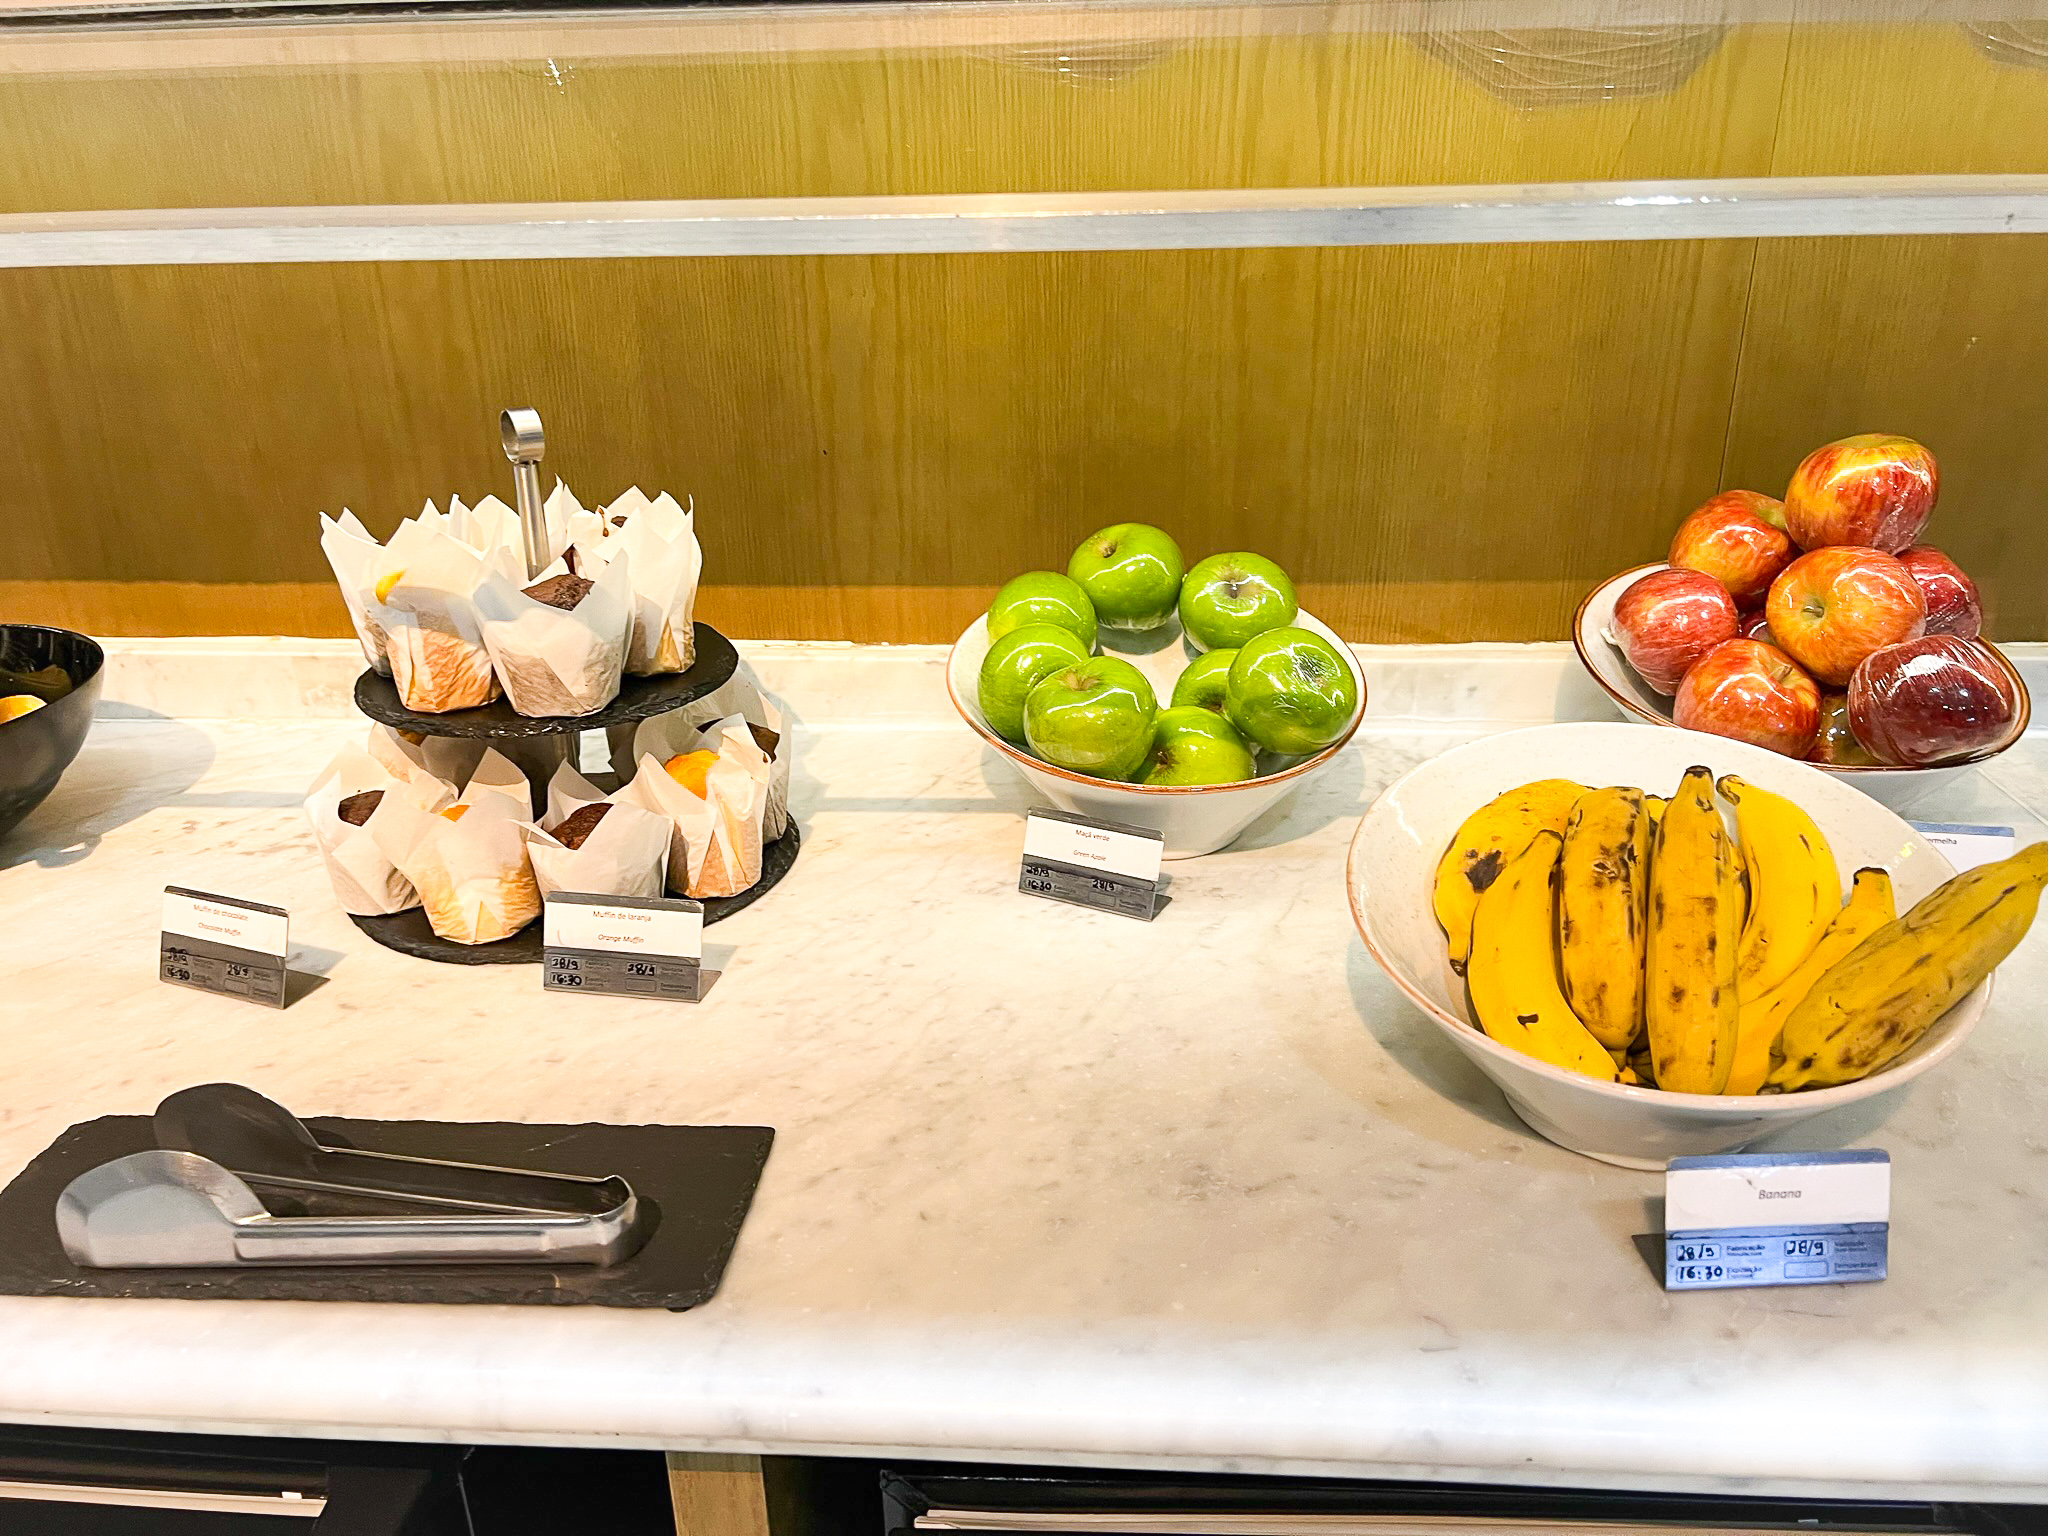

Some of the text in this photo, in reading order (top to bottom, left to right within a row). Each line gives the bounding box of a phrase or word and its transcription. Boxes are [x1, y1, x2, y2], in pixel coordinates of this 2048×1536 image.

[1926, 837, 1958, 846] ermelha
[592, 910, 652, 923] Muffin de laranja
[622, 935, 645, 945] Muffin
[1758, 1189, 1802, 1200] Banana
